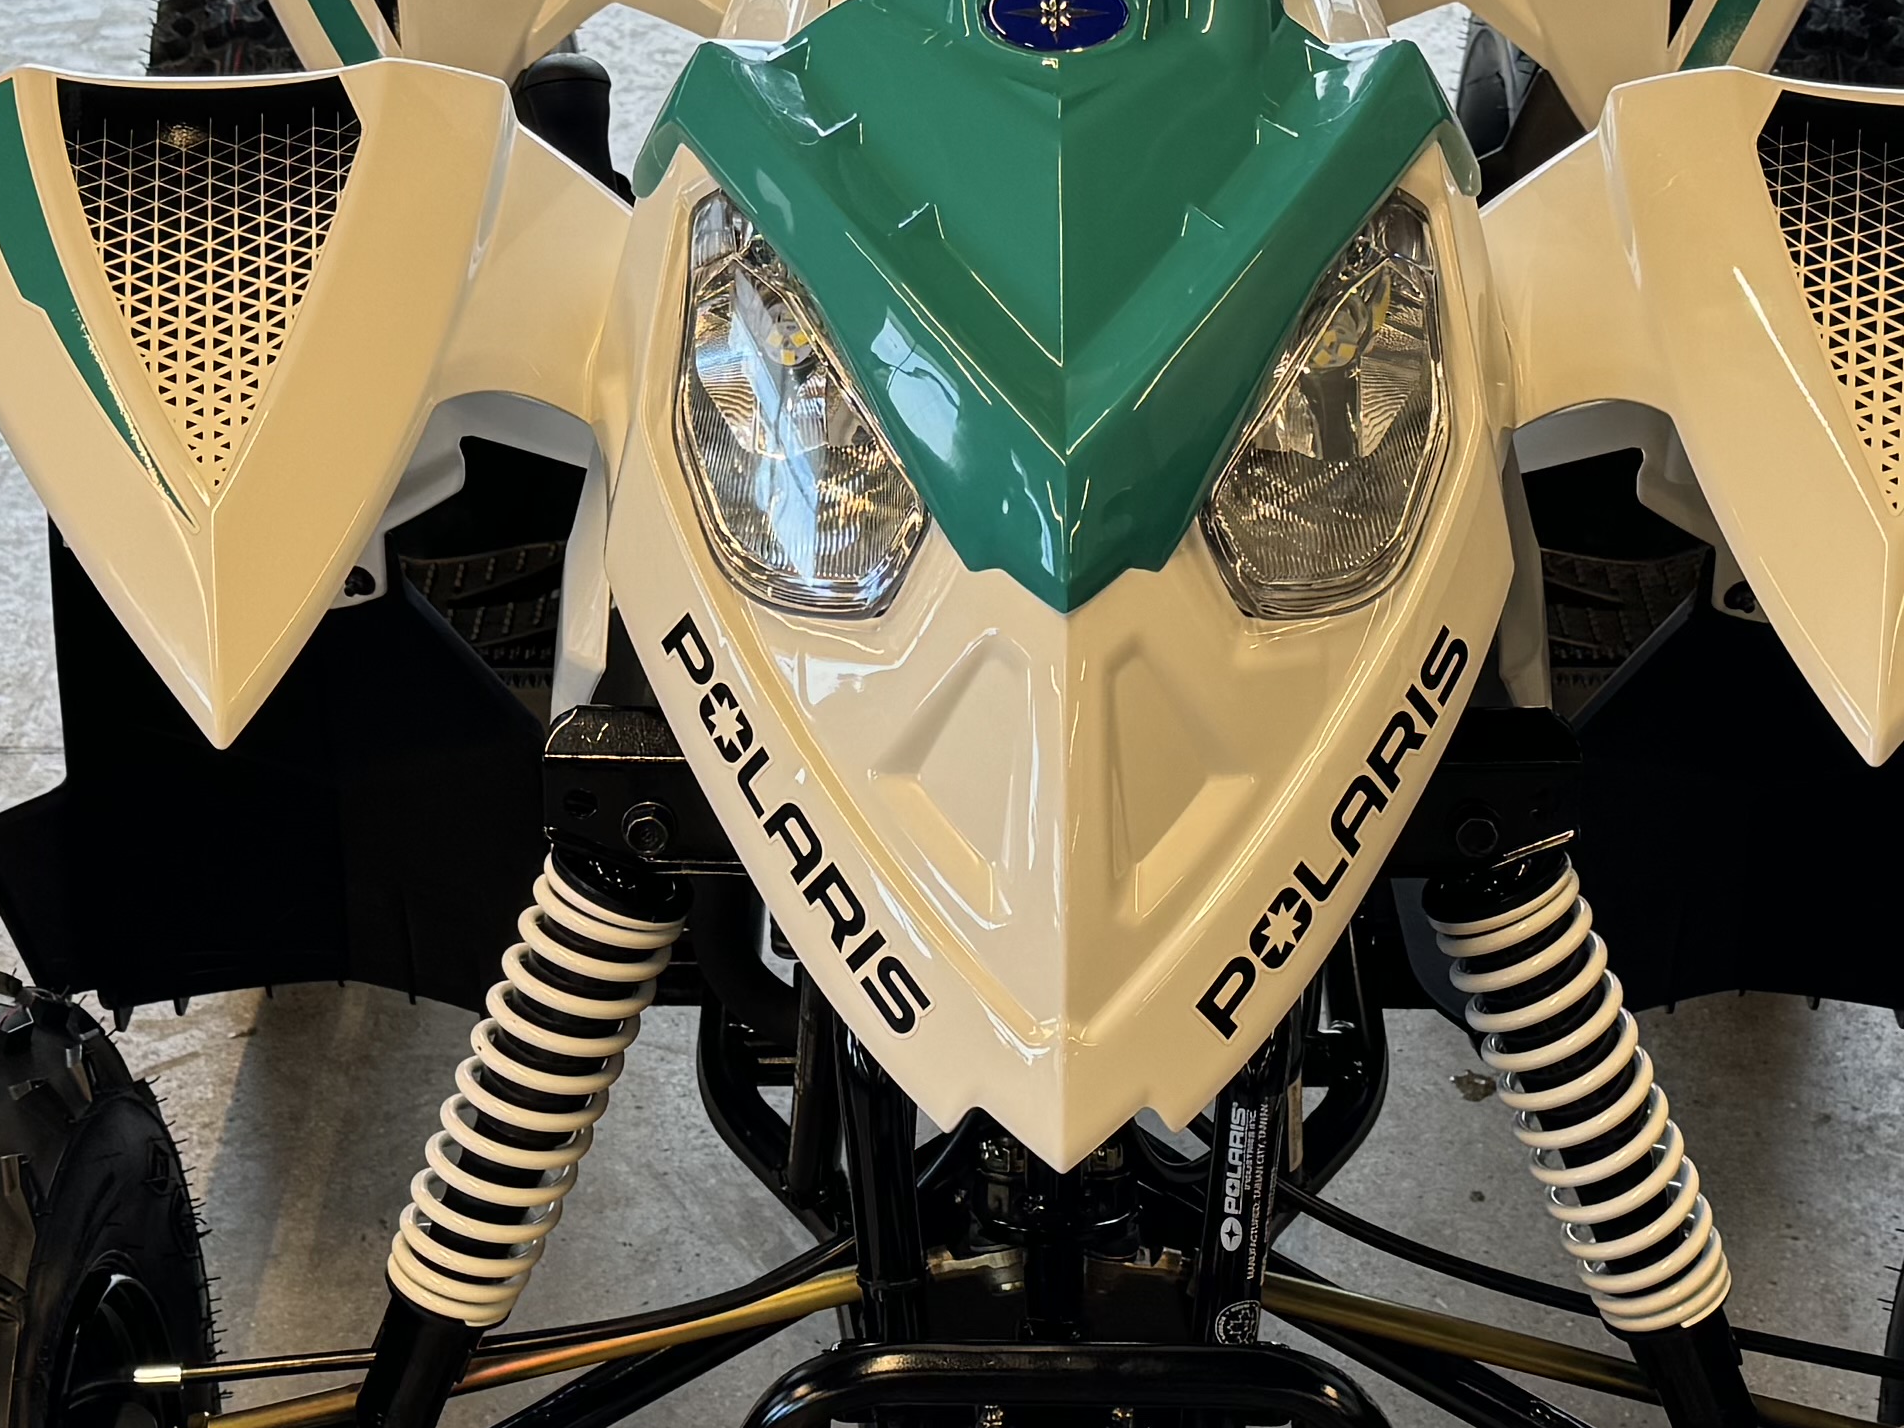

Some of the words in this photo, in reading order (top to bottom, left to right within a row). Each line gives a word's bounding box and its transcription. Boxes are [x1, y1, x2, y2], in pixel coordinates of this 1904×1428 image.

[661, 612, 931, 1035] POLARIS
[1195, 624, 1469, 1040] POLARIS
[1223, 1106, 1245, 1214] POLARIS
